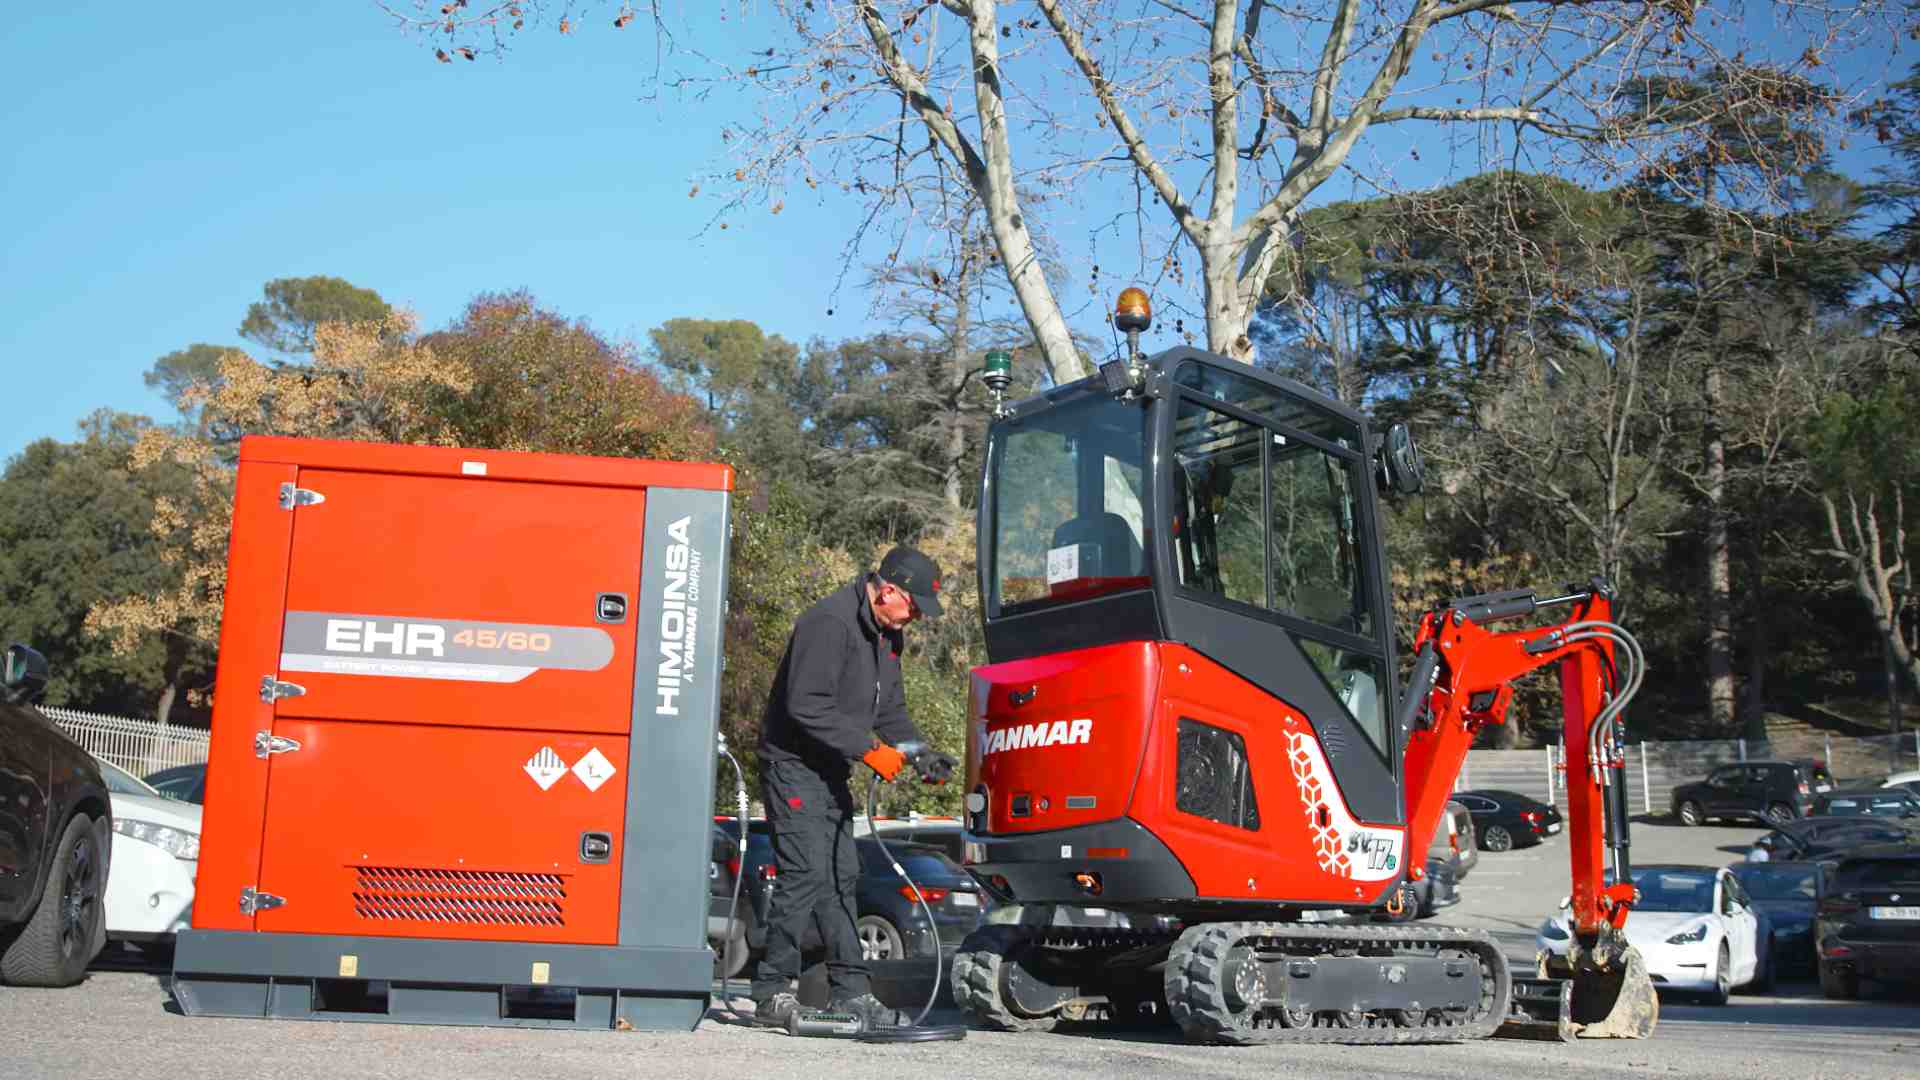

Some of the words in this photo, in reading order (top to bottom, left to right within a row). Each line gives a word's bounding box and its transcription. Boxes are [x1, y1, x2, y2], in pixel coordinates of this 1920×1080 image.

[689, 549, 702, 602] COMPANY
[325, 618, 446, 657] EHR
[452, 627, 553, 653] 45/60
[656, 515, 691, 716] HIMOINSA
[684, 606, 698, 670] YANMAR
[683, 673, 694, 683] A
[982, 719, 1093, 755] YANMAR
